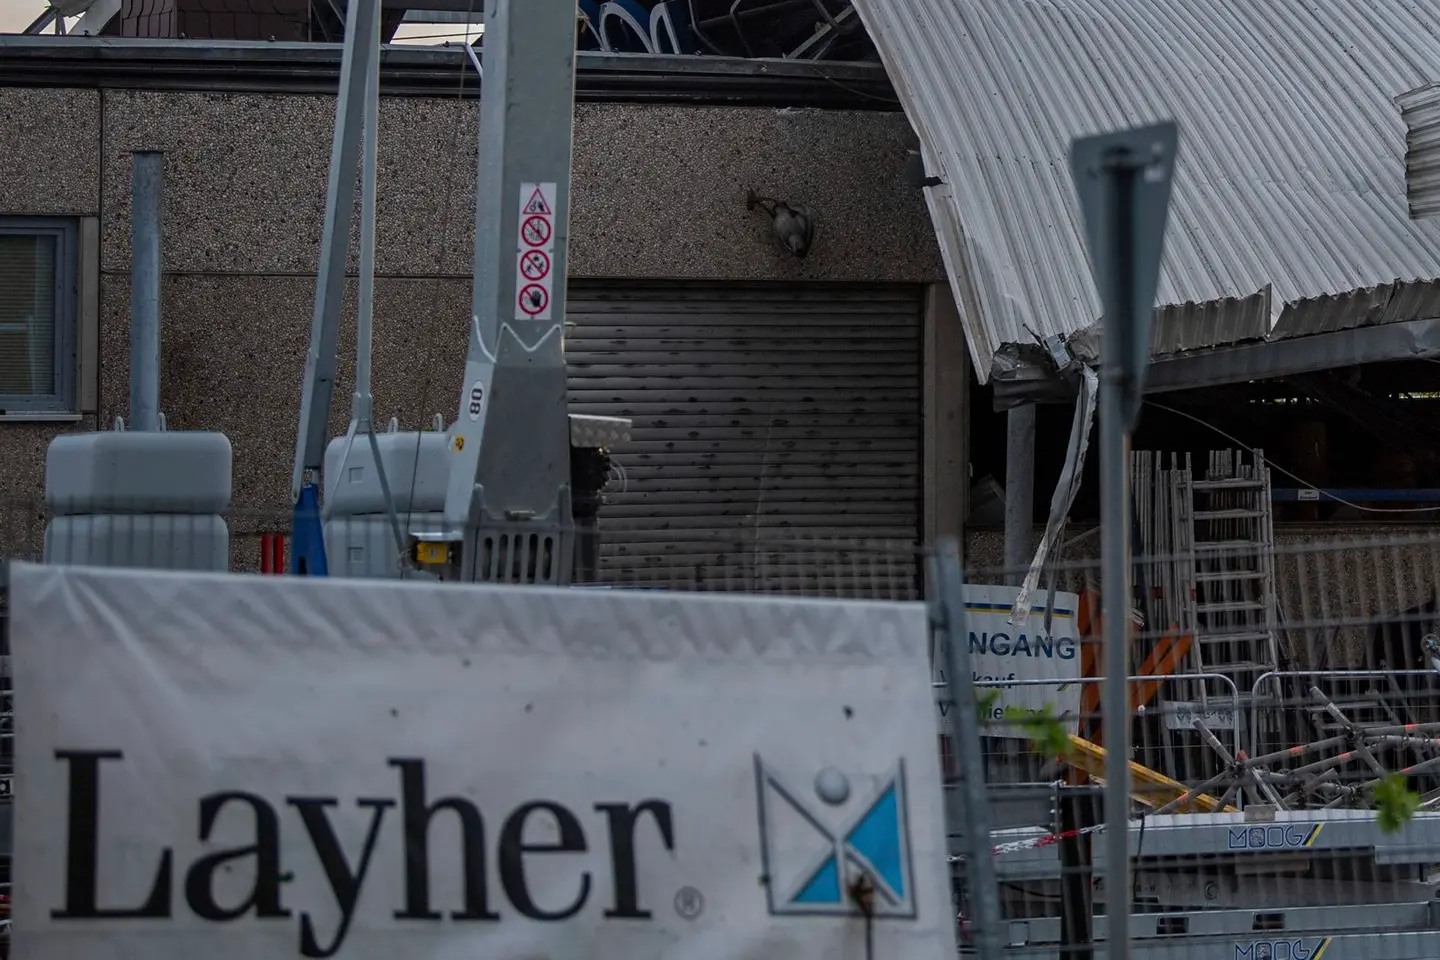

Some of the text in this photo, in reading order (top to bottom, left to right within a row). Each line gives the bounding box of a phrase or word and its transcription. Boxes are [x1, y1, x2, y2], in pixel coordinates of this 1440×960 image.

[469, 388, 483, 414] 80
[941, 631, 1076, 660] NGANG
[1228, 825, 1303, 849] MOOG
[49, 749, 675, 960] Layher
